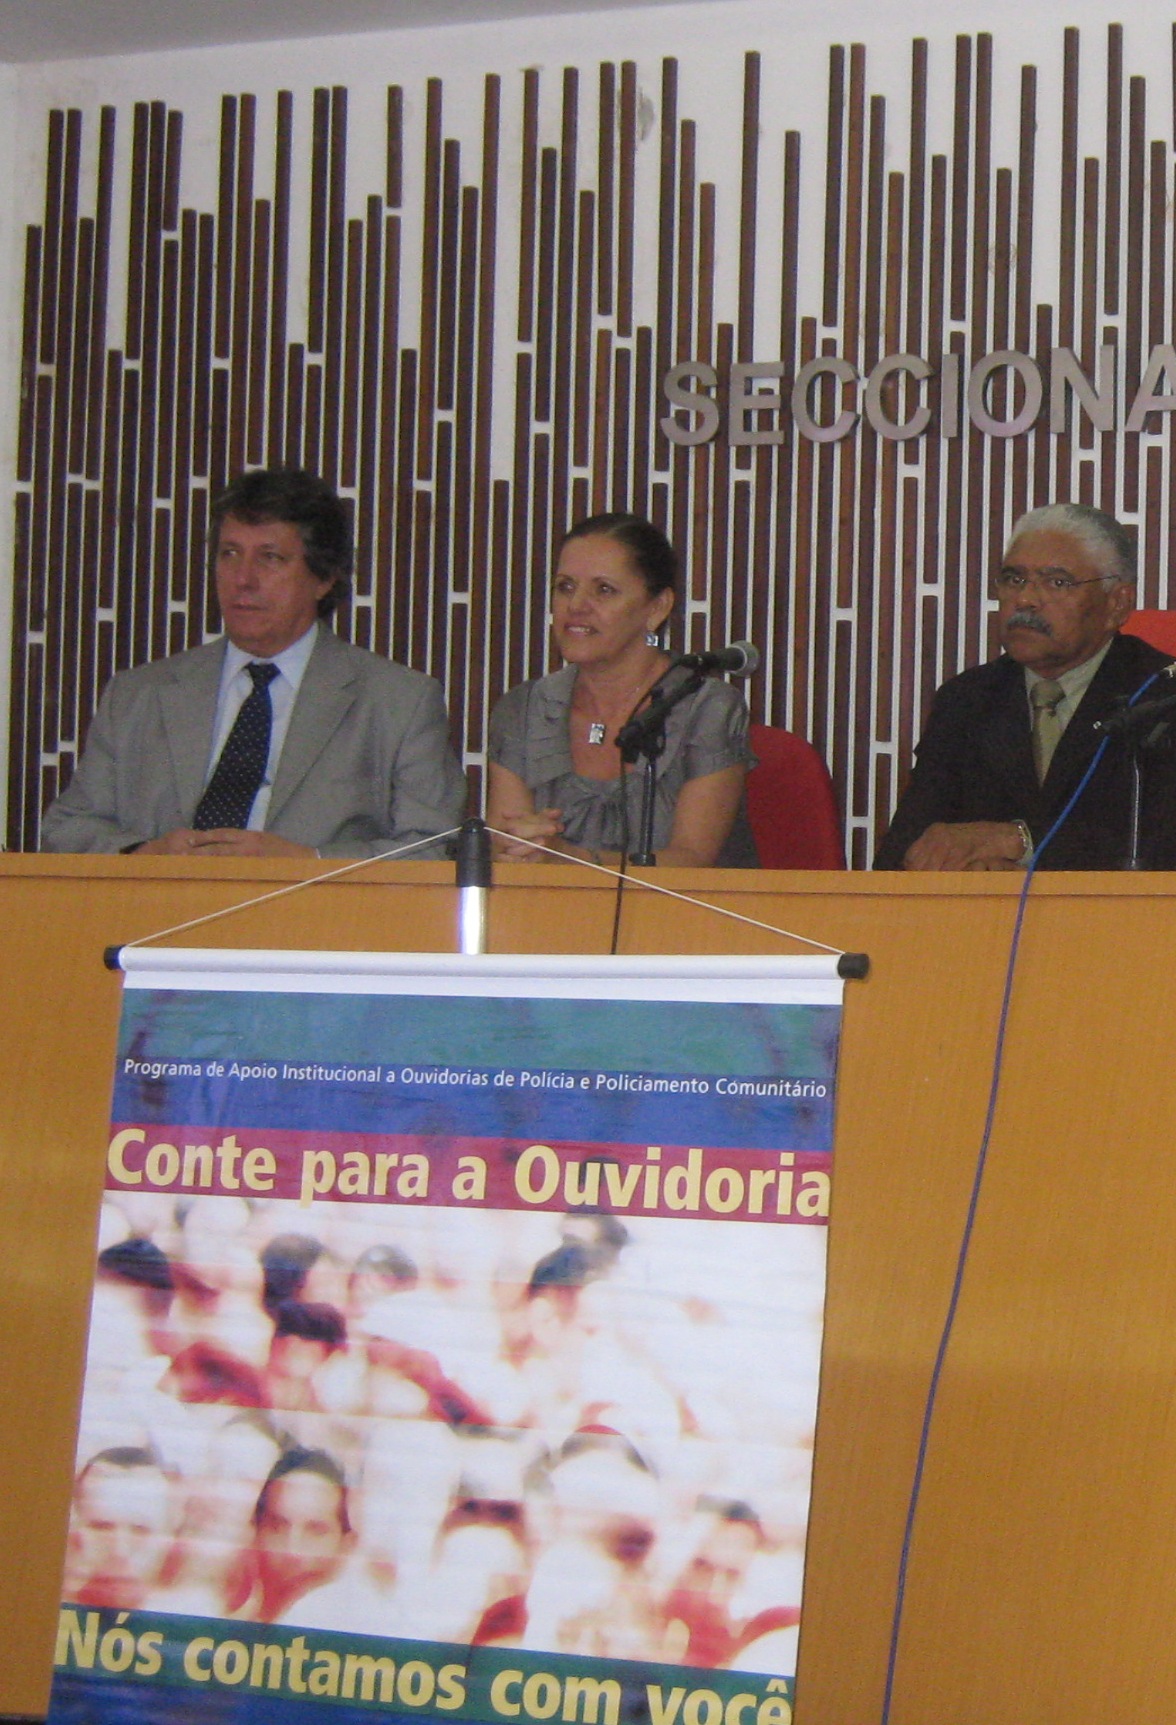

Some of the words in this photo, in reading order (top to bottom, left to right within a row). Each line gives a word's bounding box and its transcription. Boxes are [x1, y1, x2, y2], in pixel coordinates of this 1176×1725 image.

[124, 1059, 201, 1079] Programa
[206, 1061, 224, 1077] de
[228, 1063, 277, 1080] Apoio
[282, 1064, 380, 1082] Institucional
[386, 1071, 395, 1083] a
[401, 1067, 489, 1086] Ouvidorias
[493, 1070, 514, 1087] de
[520, 1071, 574, 1089] Polícia
[580, 1077, 590, 1090] e
[596, 1074, 709, 1094] Policiamento
[716, 1078, 827, 1098] Comunitário
[107, 1129, 276, 1191] Conte
[300, 1150, 430, 1210] para
[452, 1155, 487, 1200] a
[514, 1145, 831, 1217] Ouvidoria
[54, 1609, 164, 1676] Nós
[183, 1635, 467, 1710] contamos
[490, 1669, 622, 1725] com
[646, 1679, 793, 1725] você
